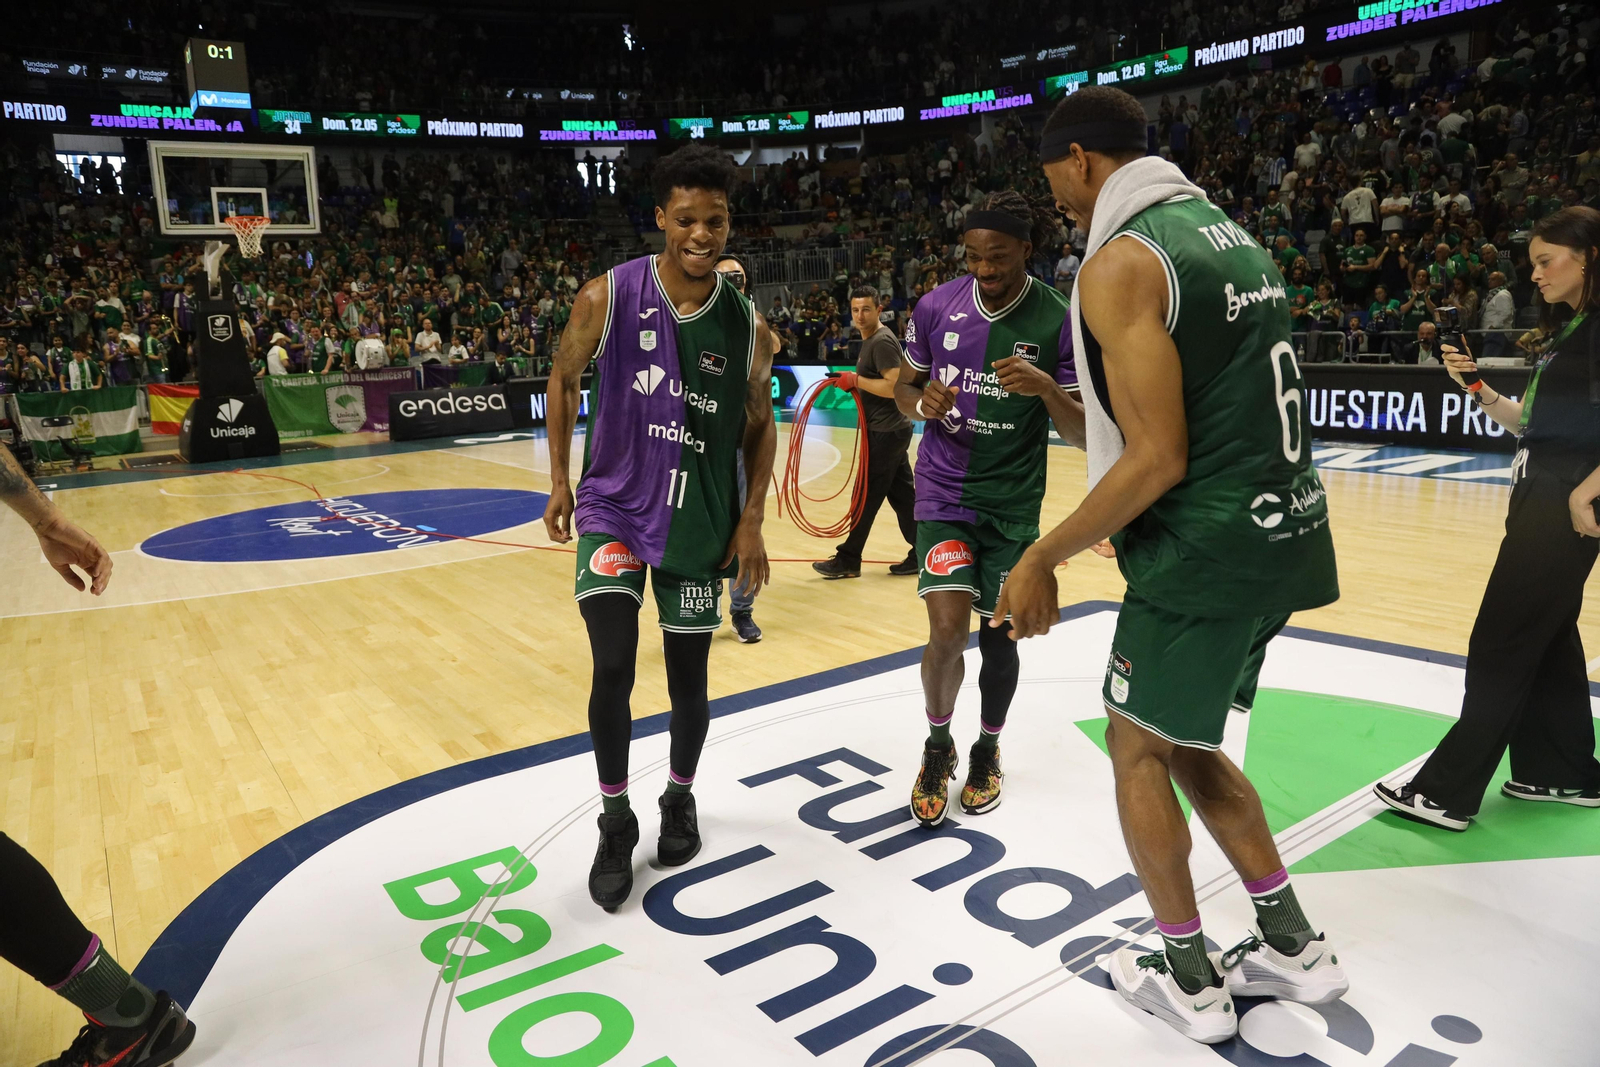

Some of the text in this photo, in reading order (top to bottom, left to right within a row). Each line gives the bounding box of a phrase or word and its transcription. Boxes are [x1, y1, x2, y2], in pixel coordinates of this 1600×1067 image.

[1326, 12, 1397, 41] ZUNDER
[207, 44, 233, 60] 0:1
[1194, 26, 1306, 67] PRÓXIMO PARTIDO
[1097, 62, 1146, 86] Dom. 12.05
[942, 89, 996, 107] UNICAJA
[3, 101, 67, 122] PARTIDO
[120, 104, 194, 119] UNICAJA
[920, 94, 1033, 120] ZUNDER PALENCIA
[90, 114, 160, 130] ZUNDER
[322, 117, 378, 132] Dom. 12.05
[387, 120, 401, 129] liga
[562, 120, 618, 131] UNICAJA
[722, 119, 770, 132] Dom. 12.05
[814, 105, 904, 129] PRÓXIMO PARTIDO
[285, 120, 301, 135] 34
[427, 118, 524, 138] PRÓXIMO PARTIDO
[540, 130, 657, 141] ZUNDER PALENCIA
[690, 125, 705, 139] 34
[962, 380, 1010, 401] Unicaja
[399, 392, 507, 418] endesa
[1270, 340, 1301, 464] 6
[210, 424, 256, 438] Unicaja
[966, 418, 987, 428] COSTA
[666, 468, 688, 509] 11
